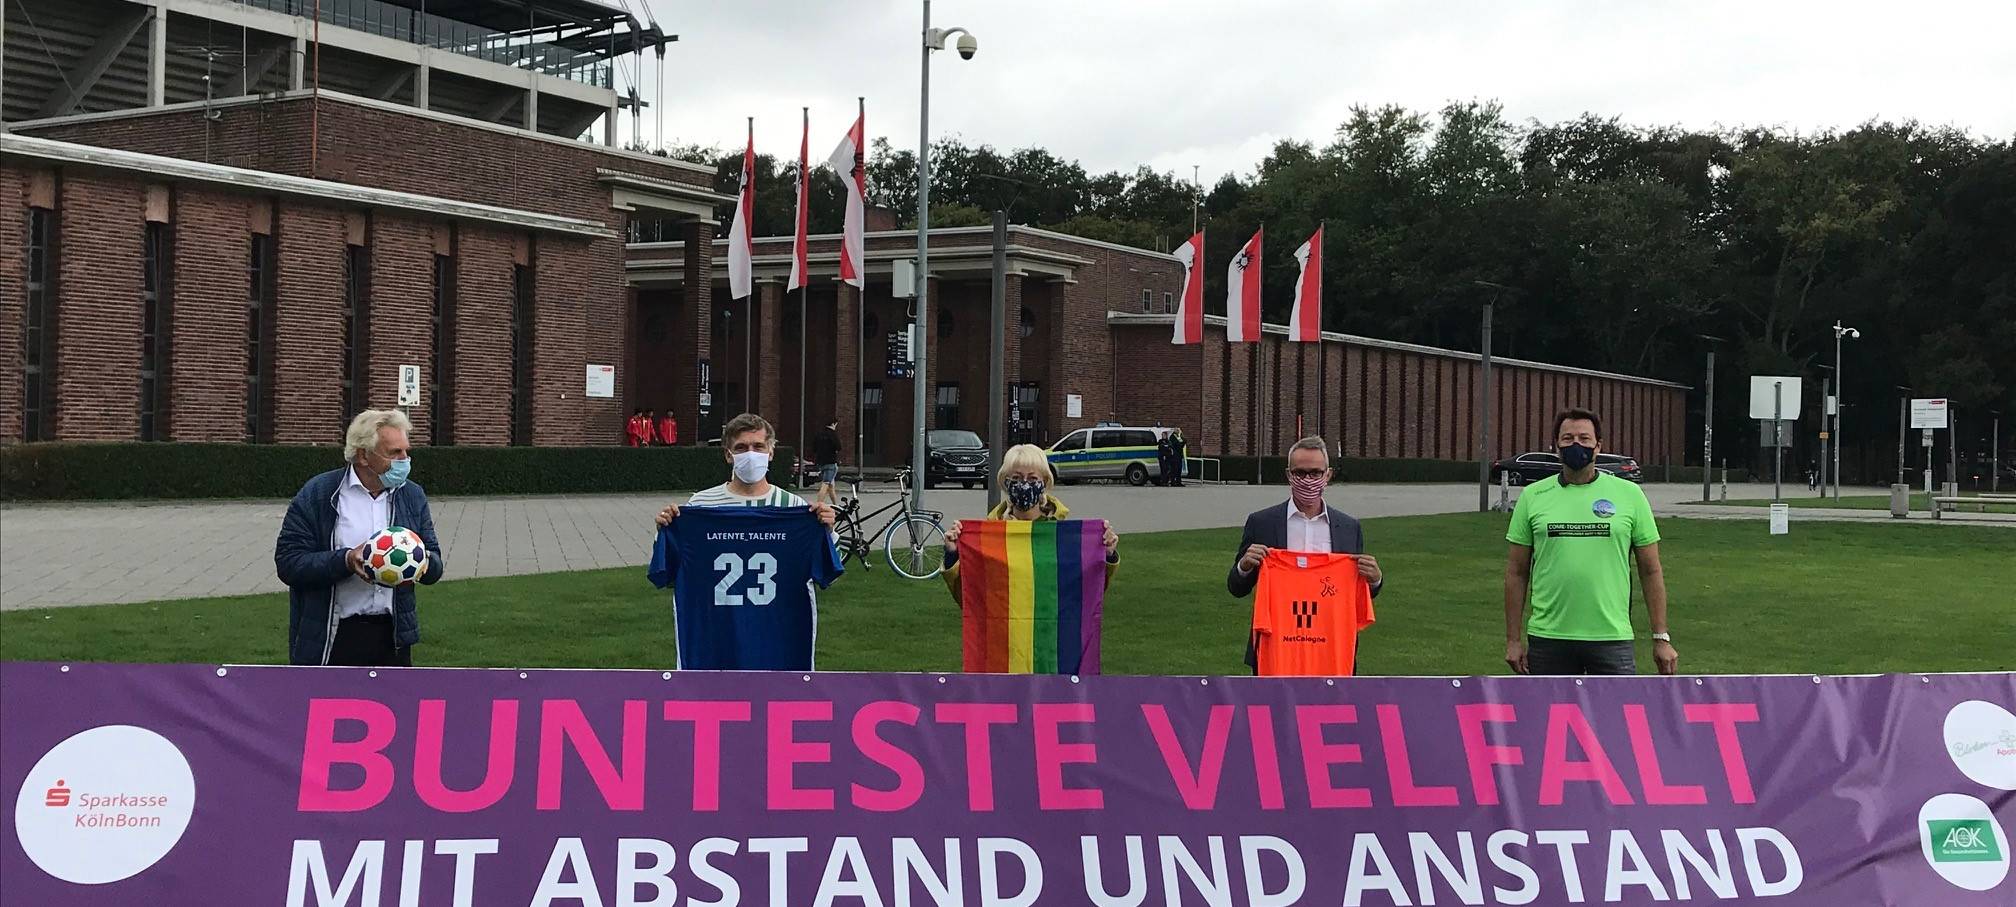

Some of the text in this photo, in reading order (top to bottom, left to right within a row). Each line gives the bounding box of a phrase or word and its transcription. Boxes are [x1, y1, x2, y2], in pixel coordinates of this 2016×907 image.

[707, 532, 786, 541] LATENTE_TALENTE
[714, 552, 777, 605] 23
[298, 699, 1760, 812] BUNTESTE VIELFALT
[79, 793, 168, 809] Sparkasse
[75, 813, 161, 828] KölnBonn
[1942, 827, 1988, 848] AOK
[285, 826, 1804, 907] MIT ABSTAND UND ANSTAND
